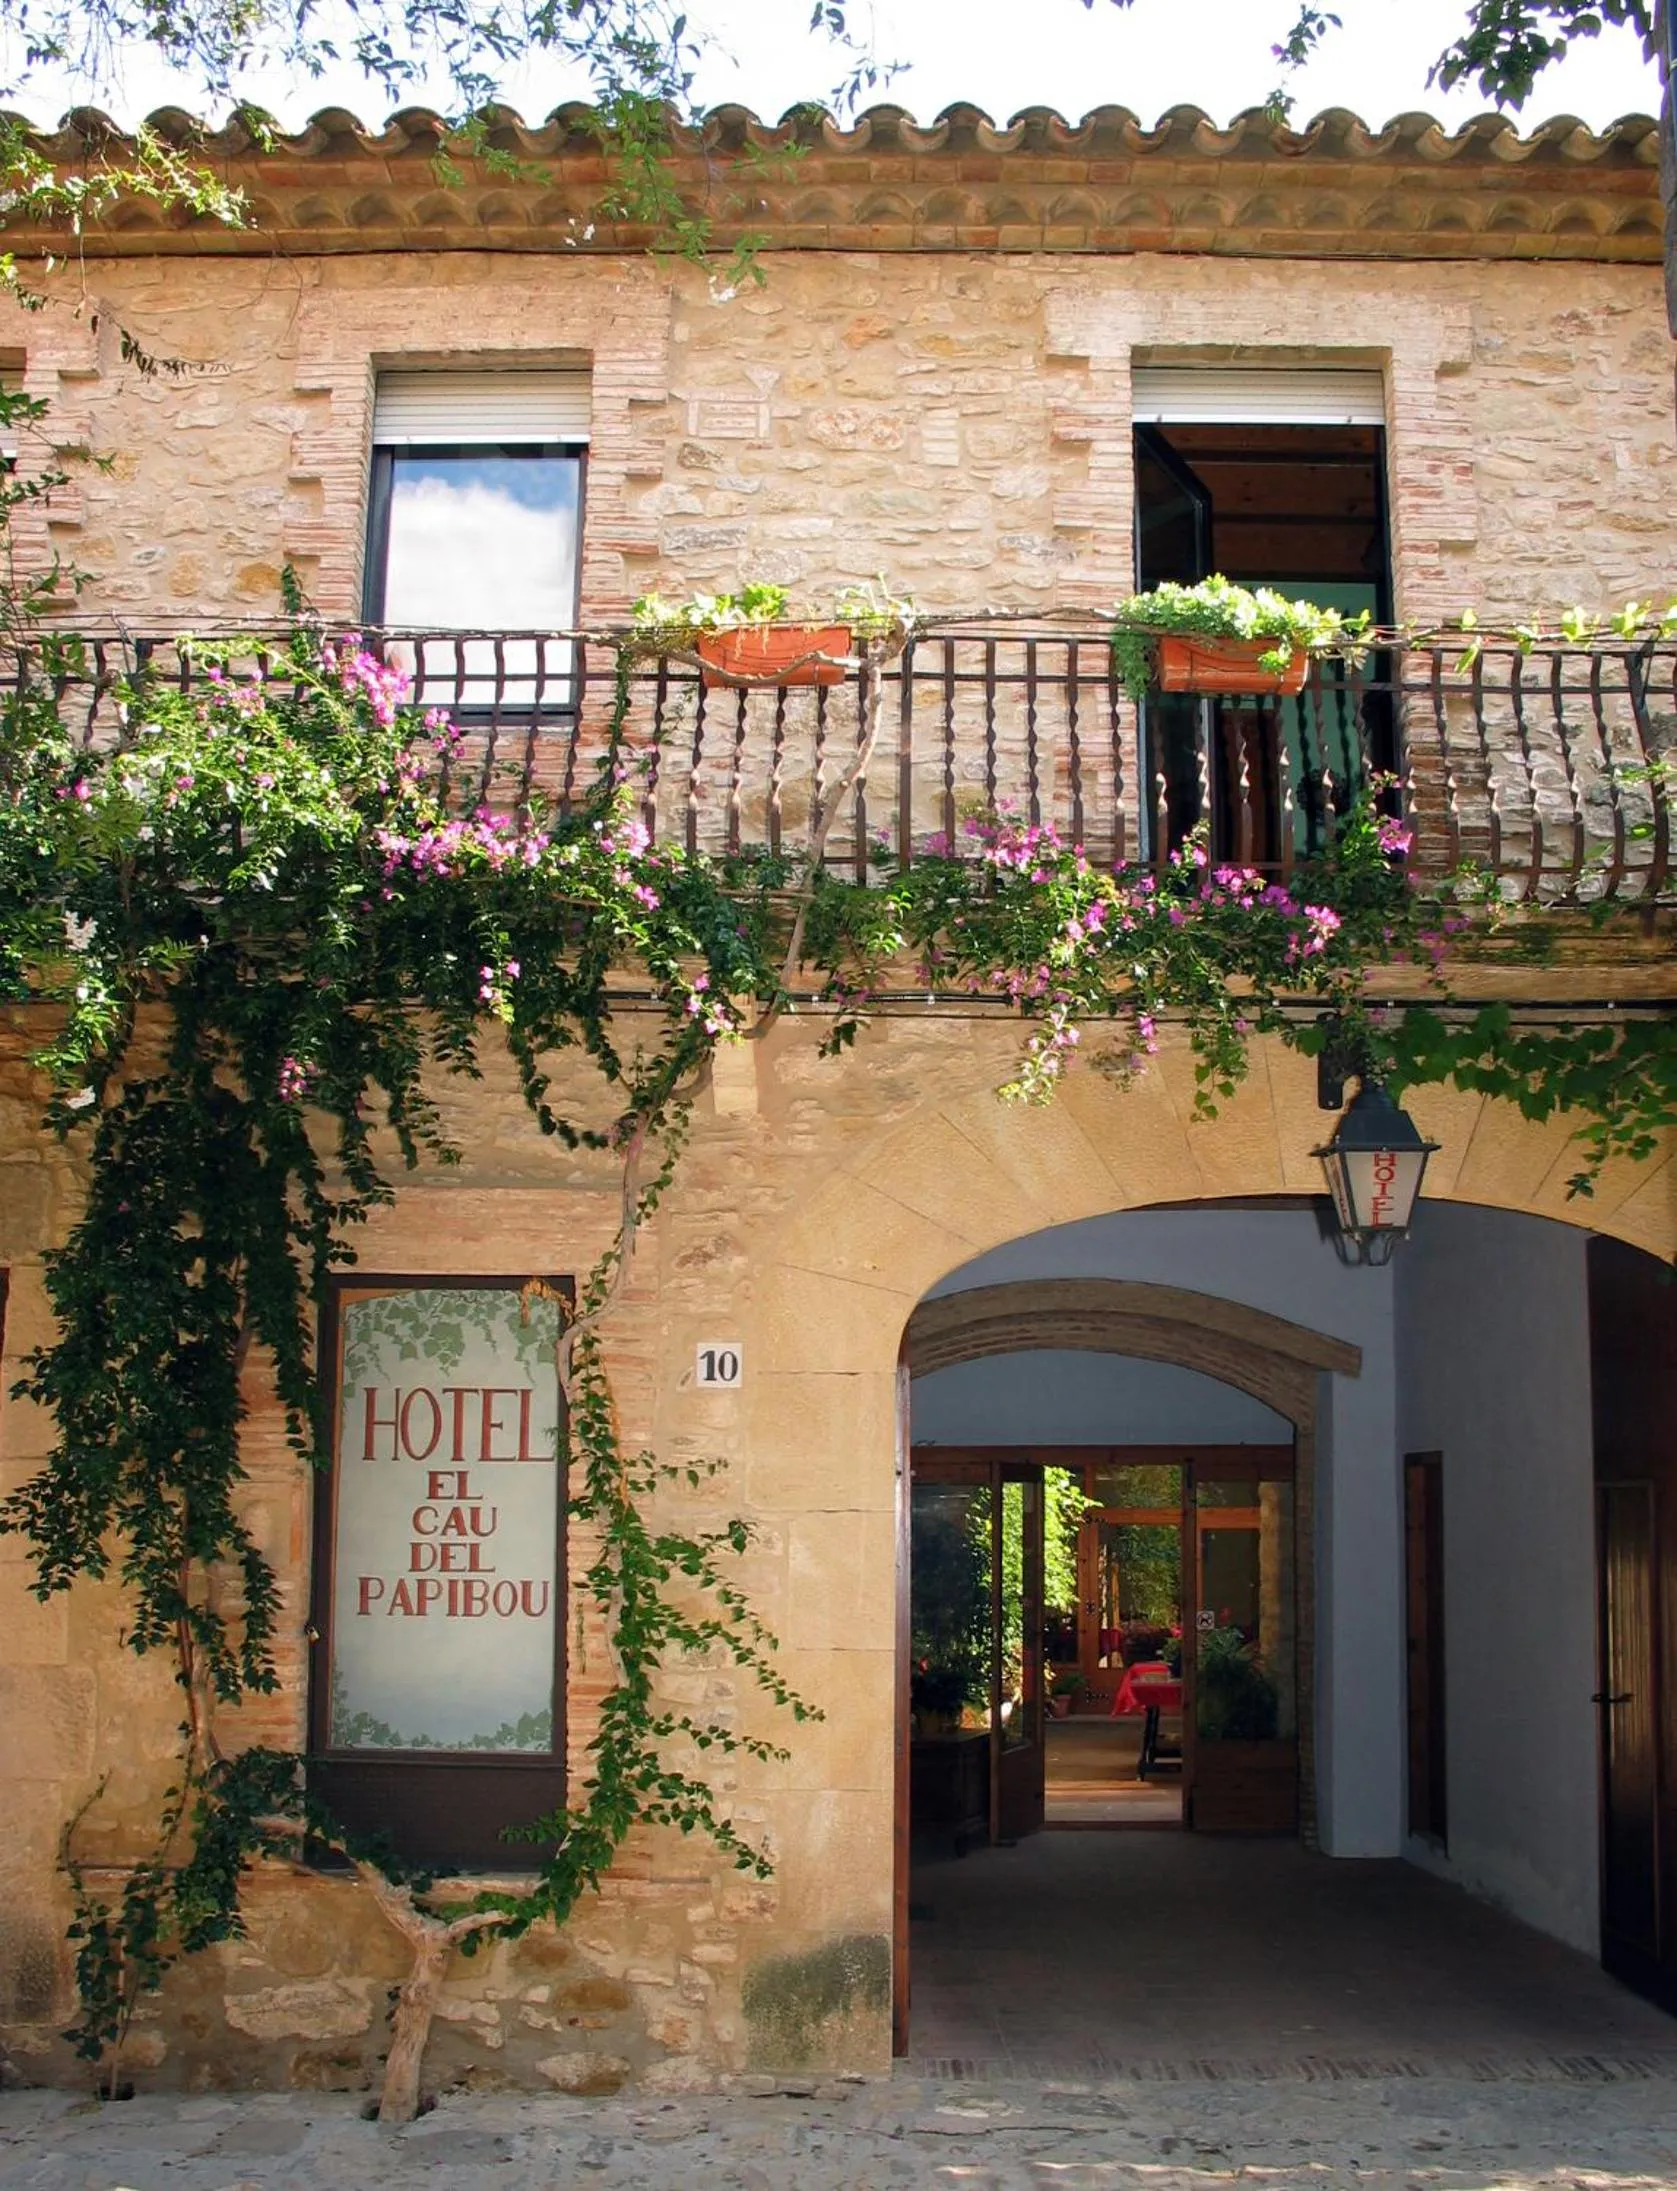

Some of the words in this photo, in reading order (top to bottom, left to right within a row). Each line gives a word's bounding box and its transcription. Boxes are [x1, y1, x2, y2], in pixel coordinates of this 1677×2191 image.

[1371, 1152, 1397, 1228] HOTEL
[699, 1349, 739, 1382] 10
[362, 1387, 555, 1461] HOTEL
[427, 1471, 483, 1500] EL
[412, 1506, 497, 1537] CAU
[409, 1543, 496, 1573] DEL
[357, 1577, 549, 1617] PAPIBOU
